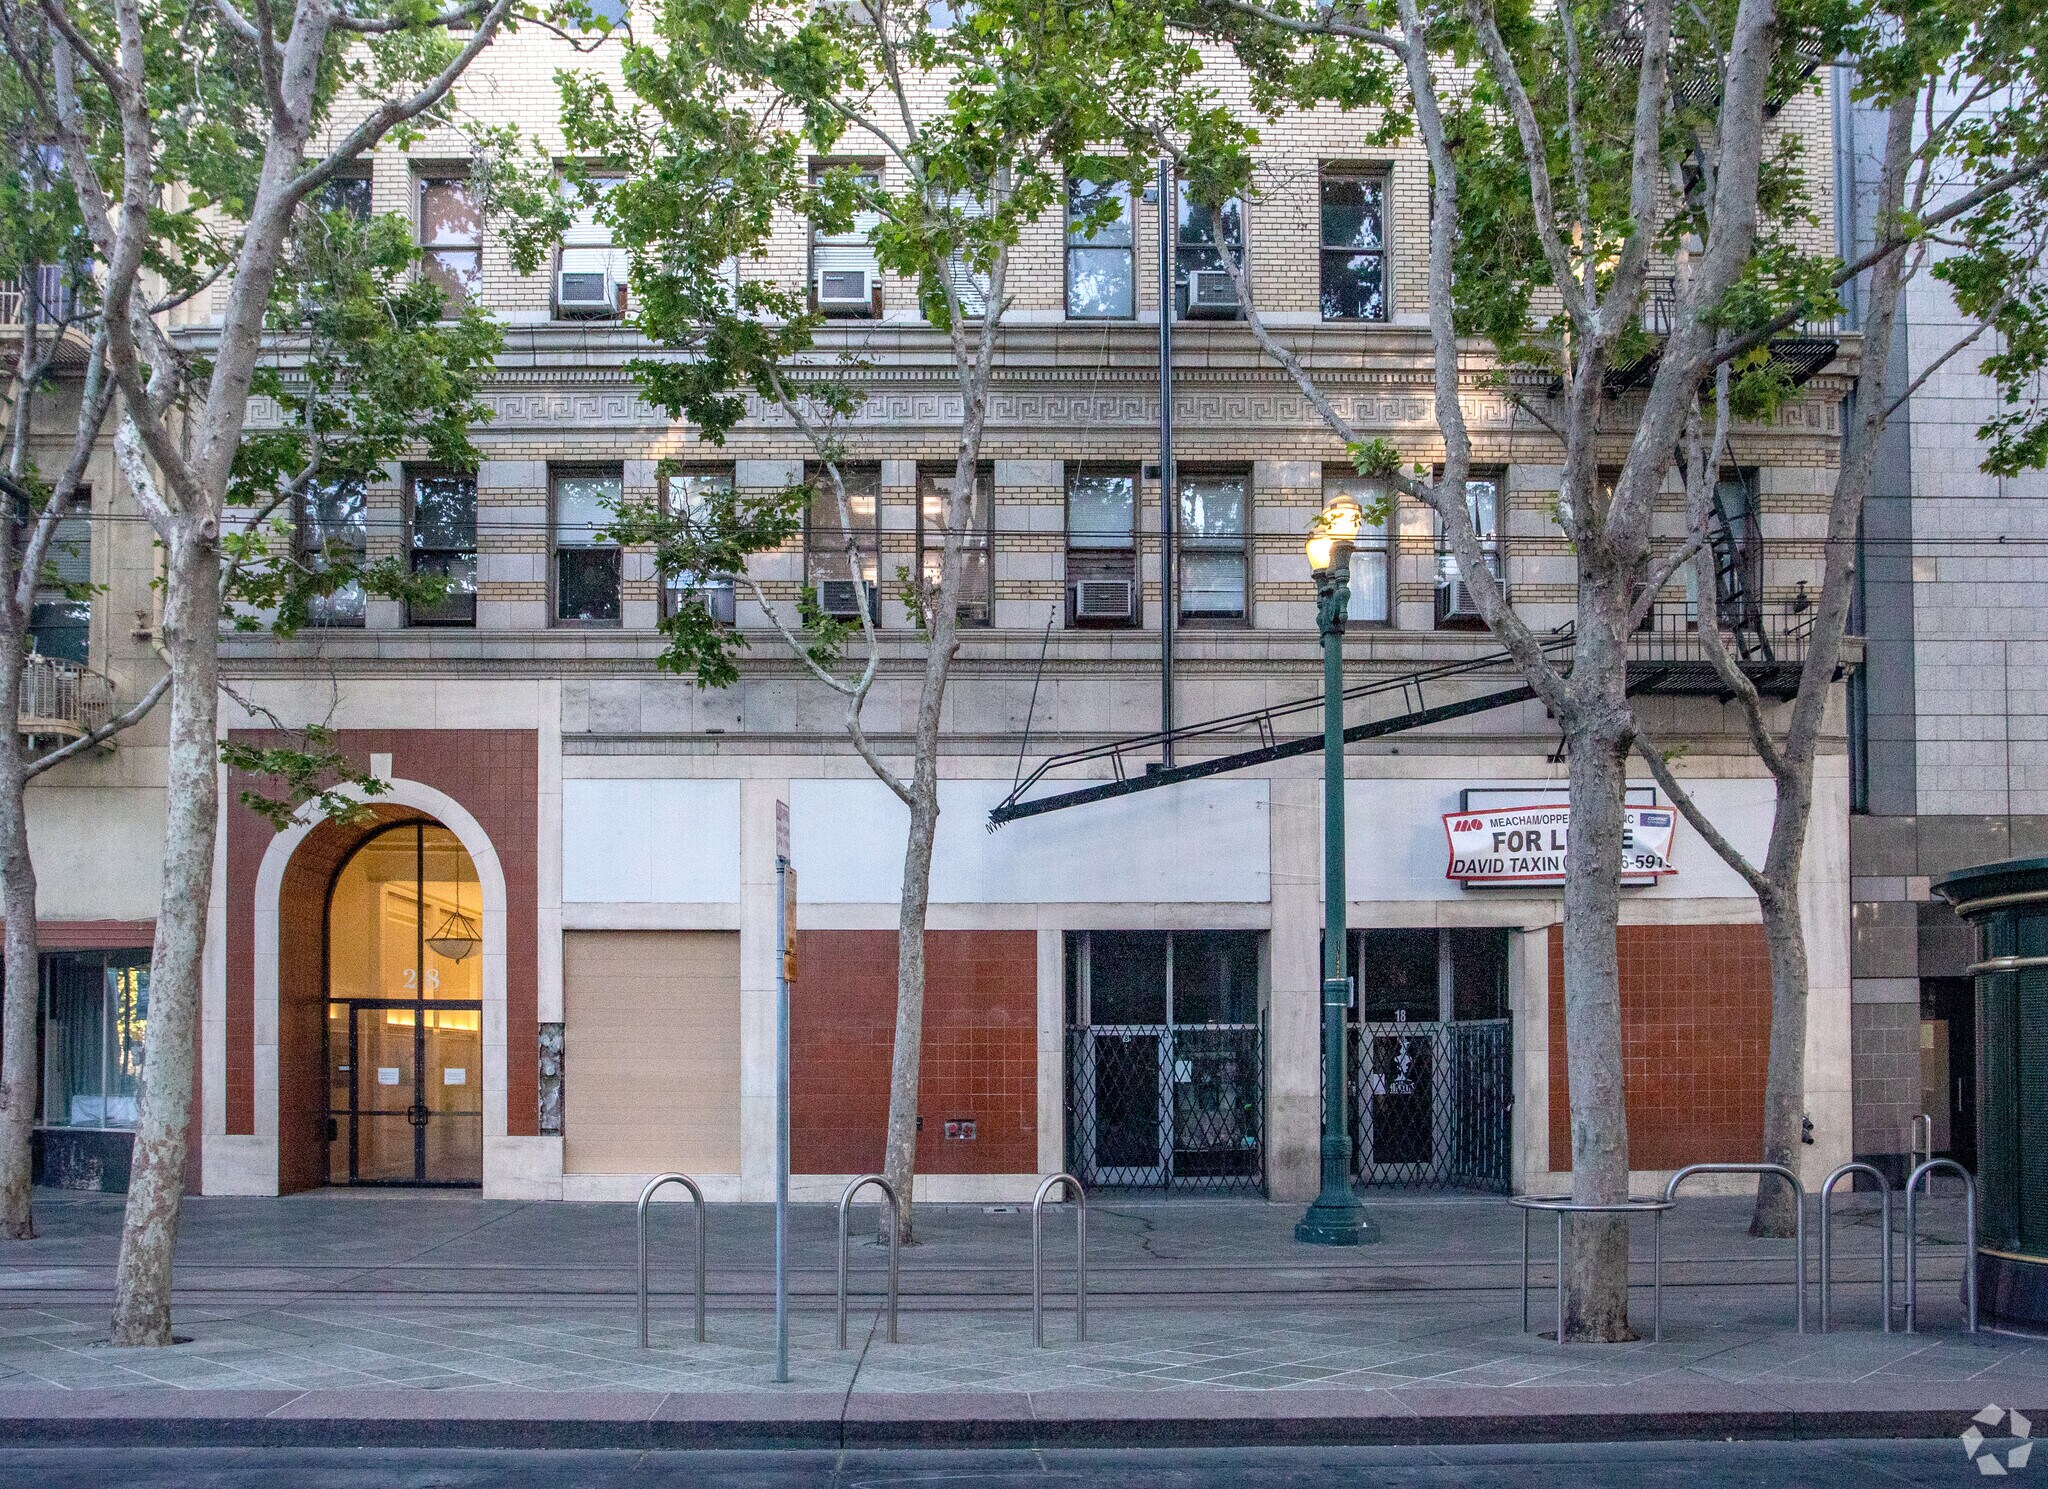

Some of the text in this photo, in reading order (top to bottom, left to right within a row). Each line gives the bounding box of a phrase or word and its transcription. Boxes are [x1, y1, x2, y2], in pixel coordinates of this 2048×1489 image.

[1490, 814, 1570, 828] MEACHAM/OPPE
[1493, 829, 1542, 853] FOR
[1453, 857, 1504, 874] DAVID
[1509, 856, 1559, 873] TAXIN
[402, 968, 440, 990] 28
[1395, 1009, 1406, 1022] 18
